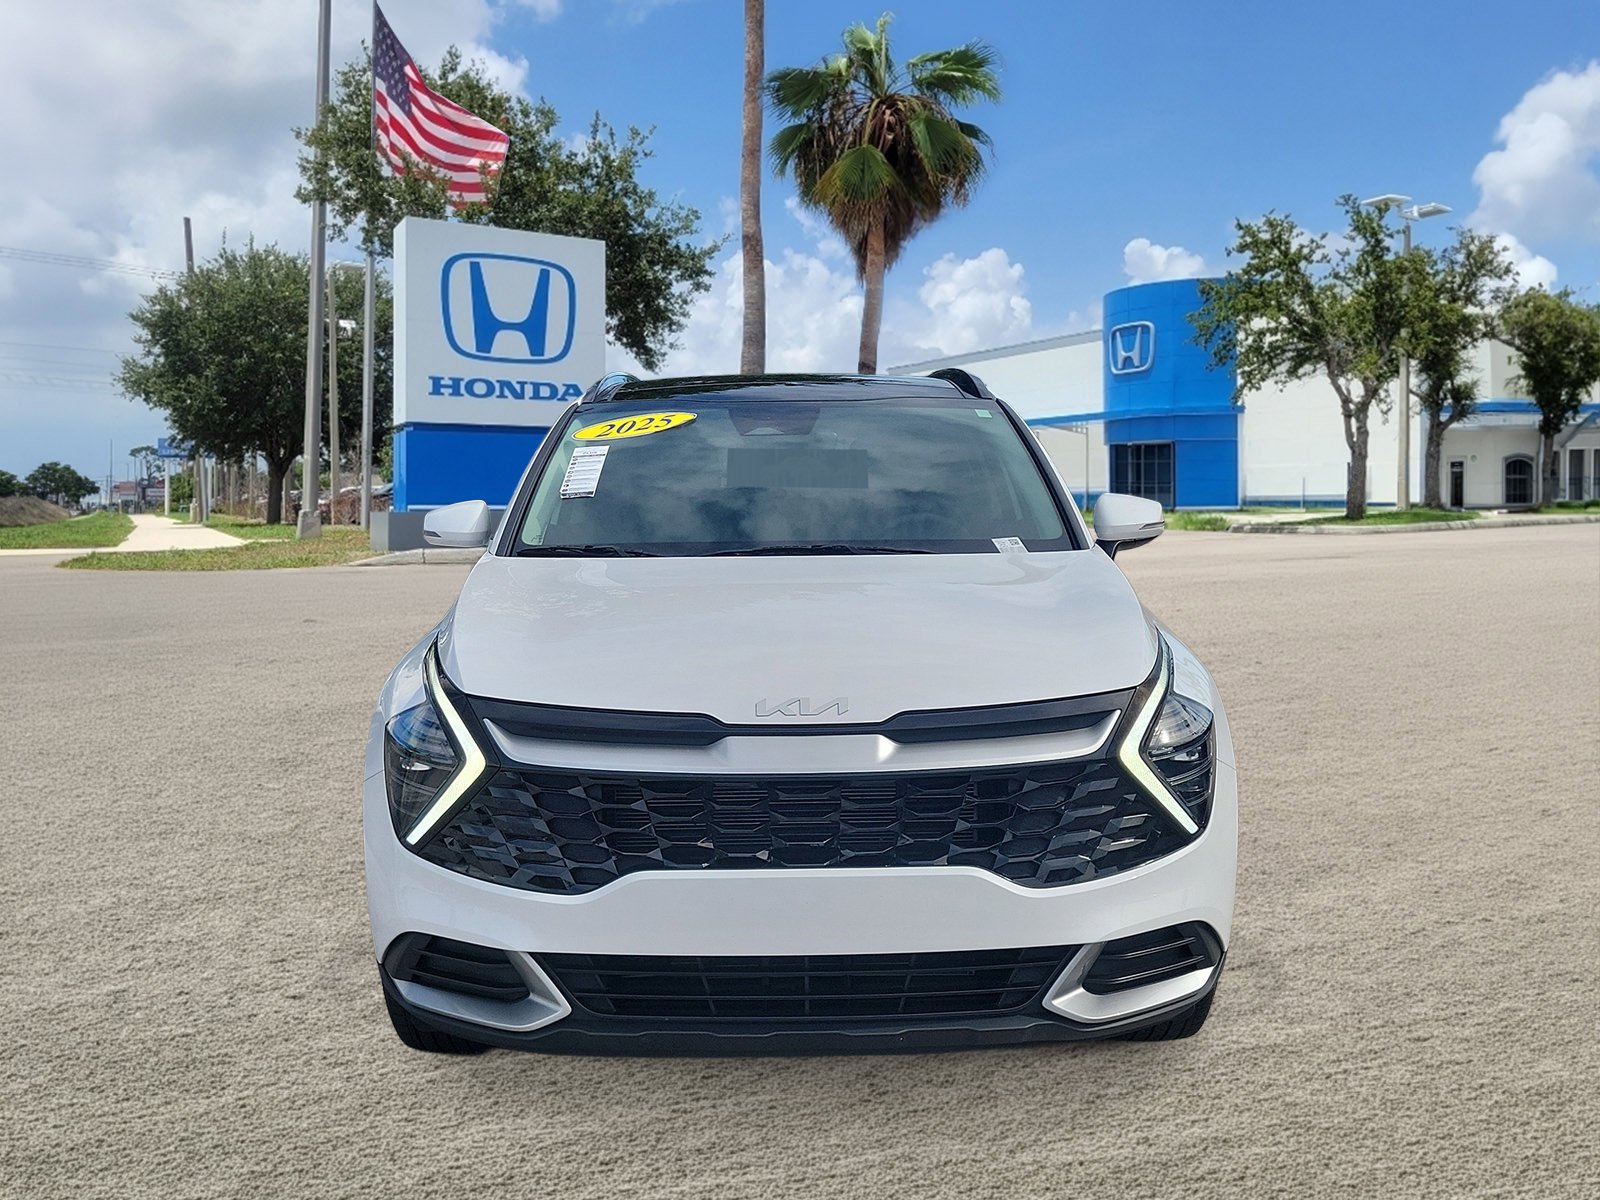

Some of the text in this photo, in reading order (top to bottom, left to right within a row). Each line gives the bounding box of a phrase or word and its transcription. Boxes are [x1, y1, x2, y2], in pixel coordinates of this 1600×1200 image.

[428, 375, 584, 401] HONDA
[595, 414, 676, 438] 2025
[755, 696, 848, 717] KIA
